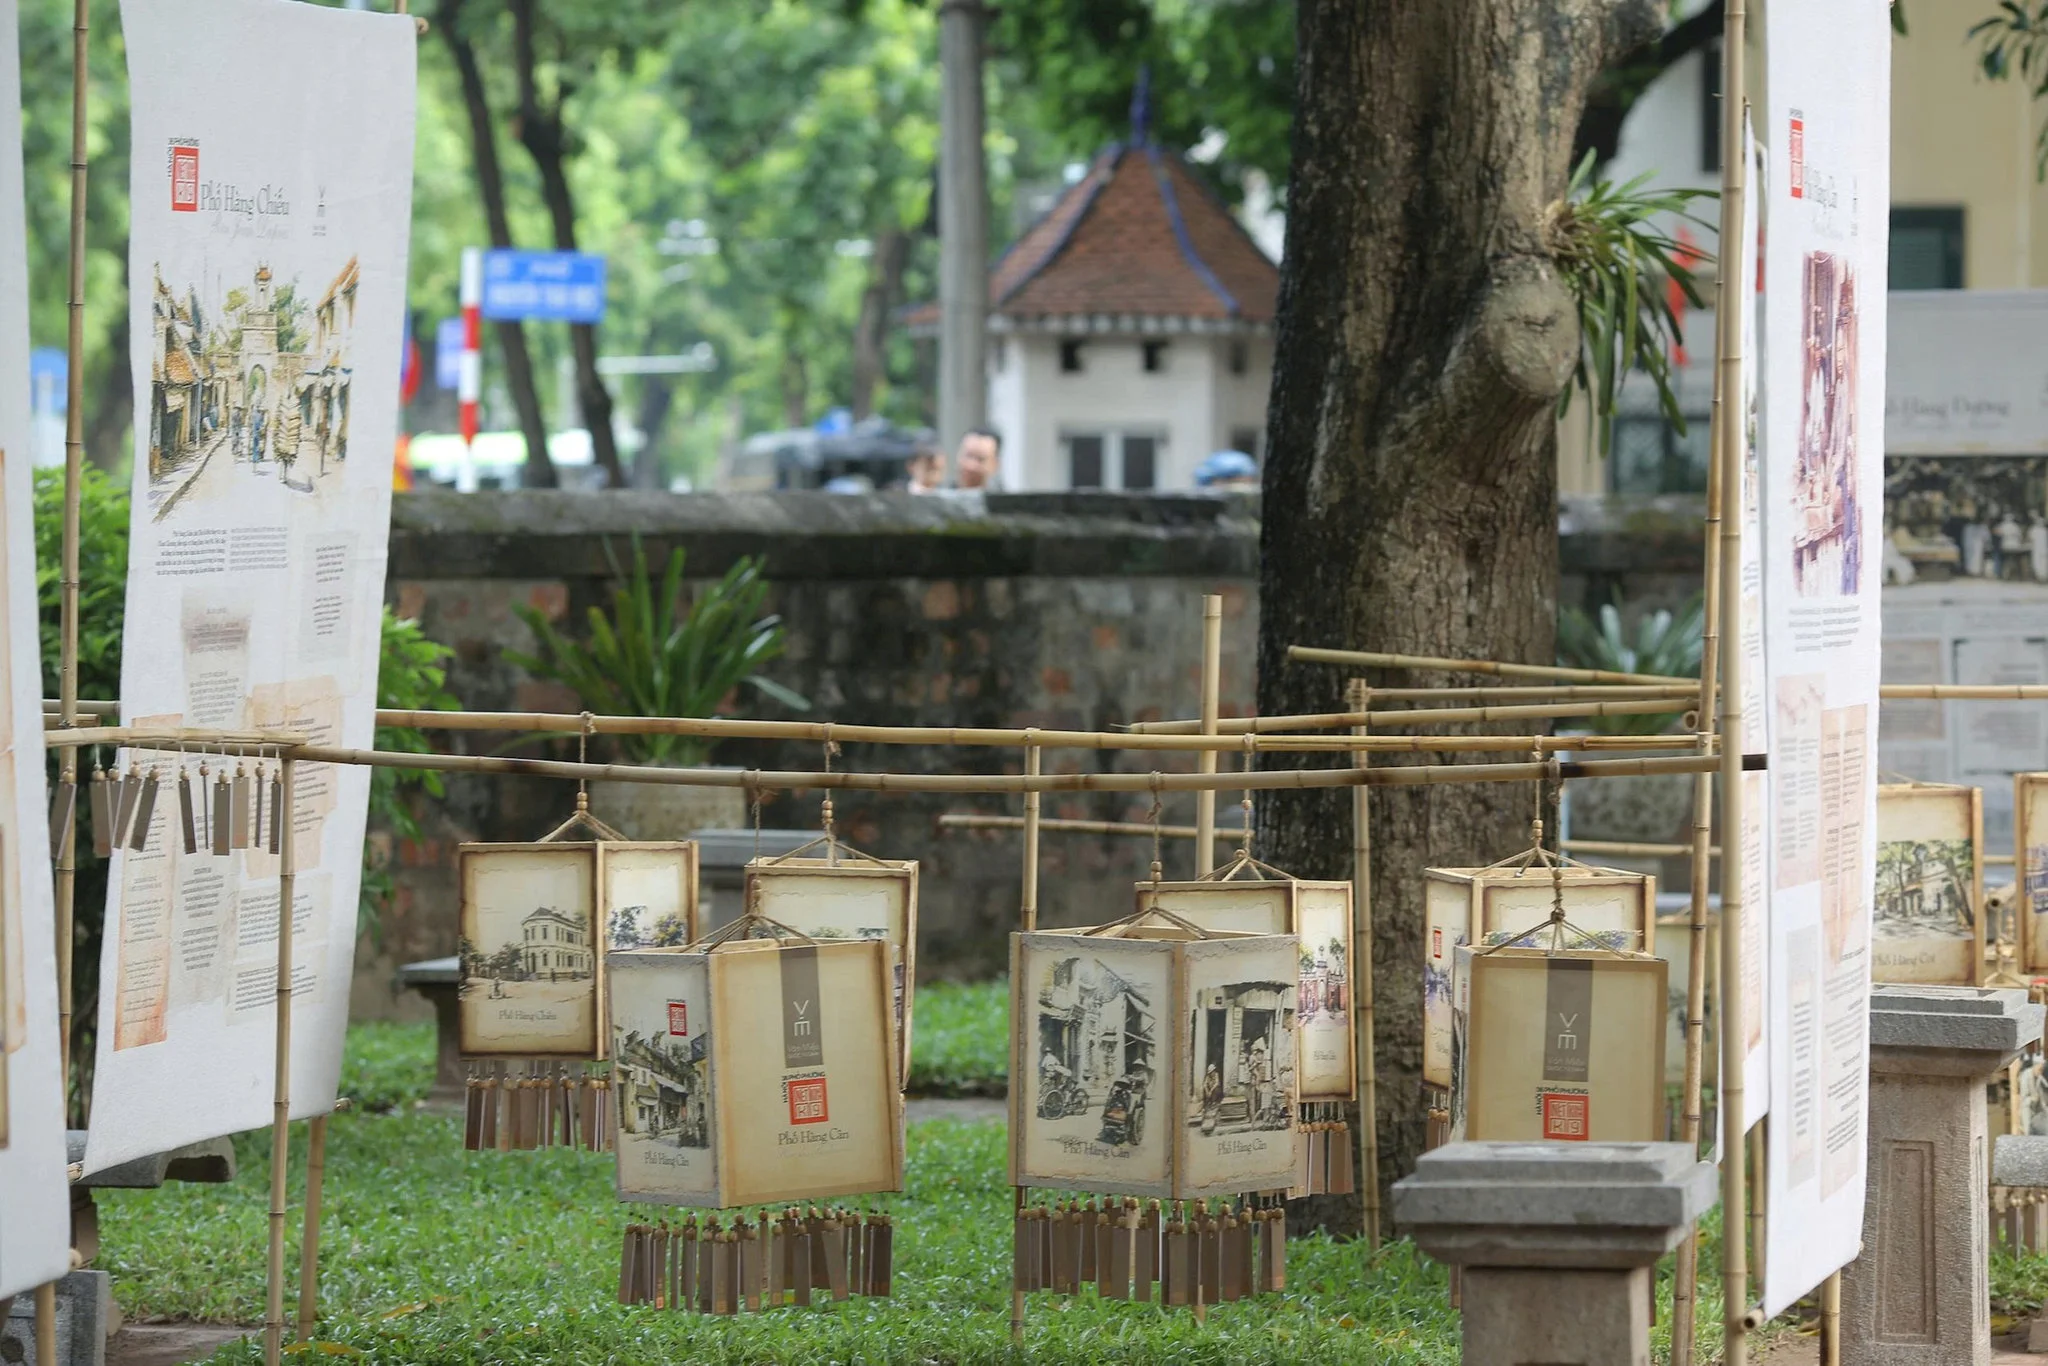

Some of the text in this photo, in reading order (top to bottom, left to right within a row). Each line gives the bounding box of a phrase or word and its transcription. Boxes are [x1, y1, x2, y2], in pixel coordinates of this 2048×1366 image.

[200, 180, 221, 211] Phố
[224, 185, 254, 220] Hàng
[256, 184, 290, 215] Chiếu
[778, 1127, 849, 1145] Phố Hàng Cân
[1217, 1140, 1232, 1155] Phố
[1233, 1140, 1252, 1155] Hàng
[644, 1151, 657, 1164] Phố
[658, 1152, 675, 1168] Hàng
